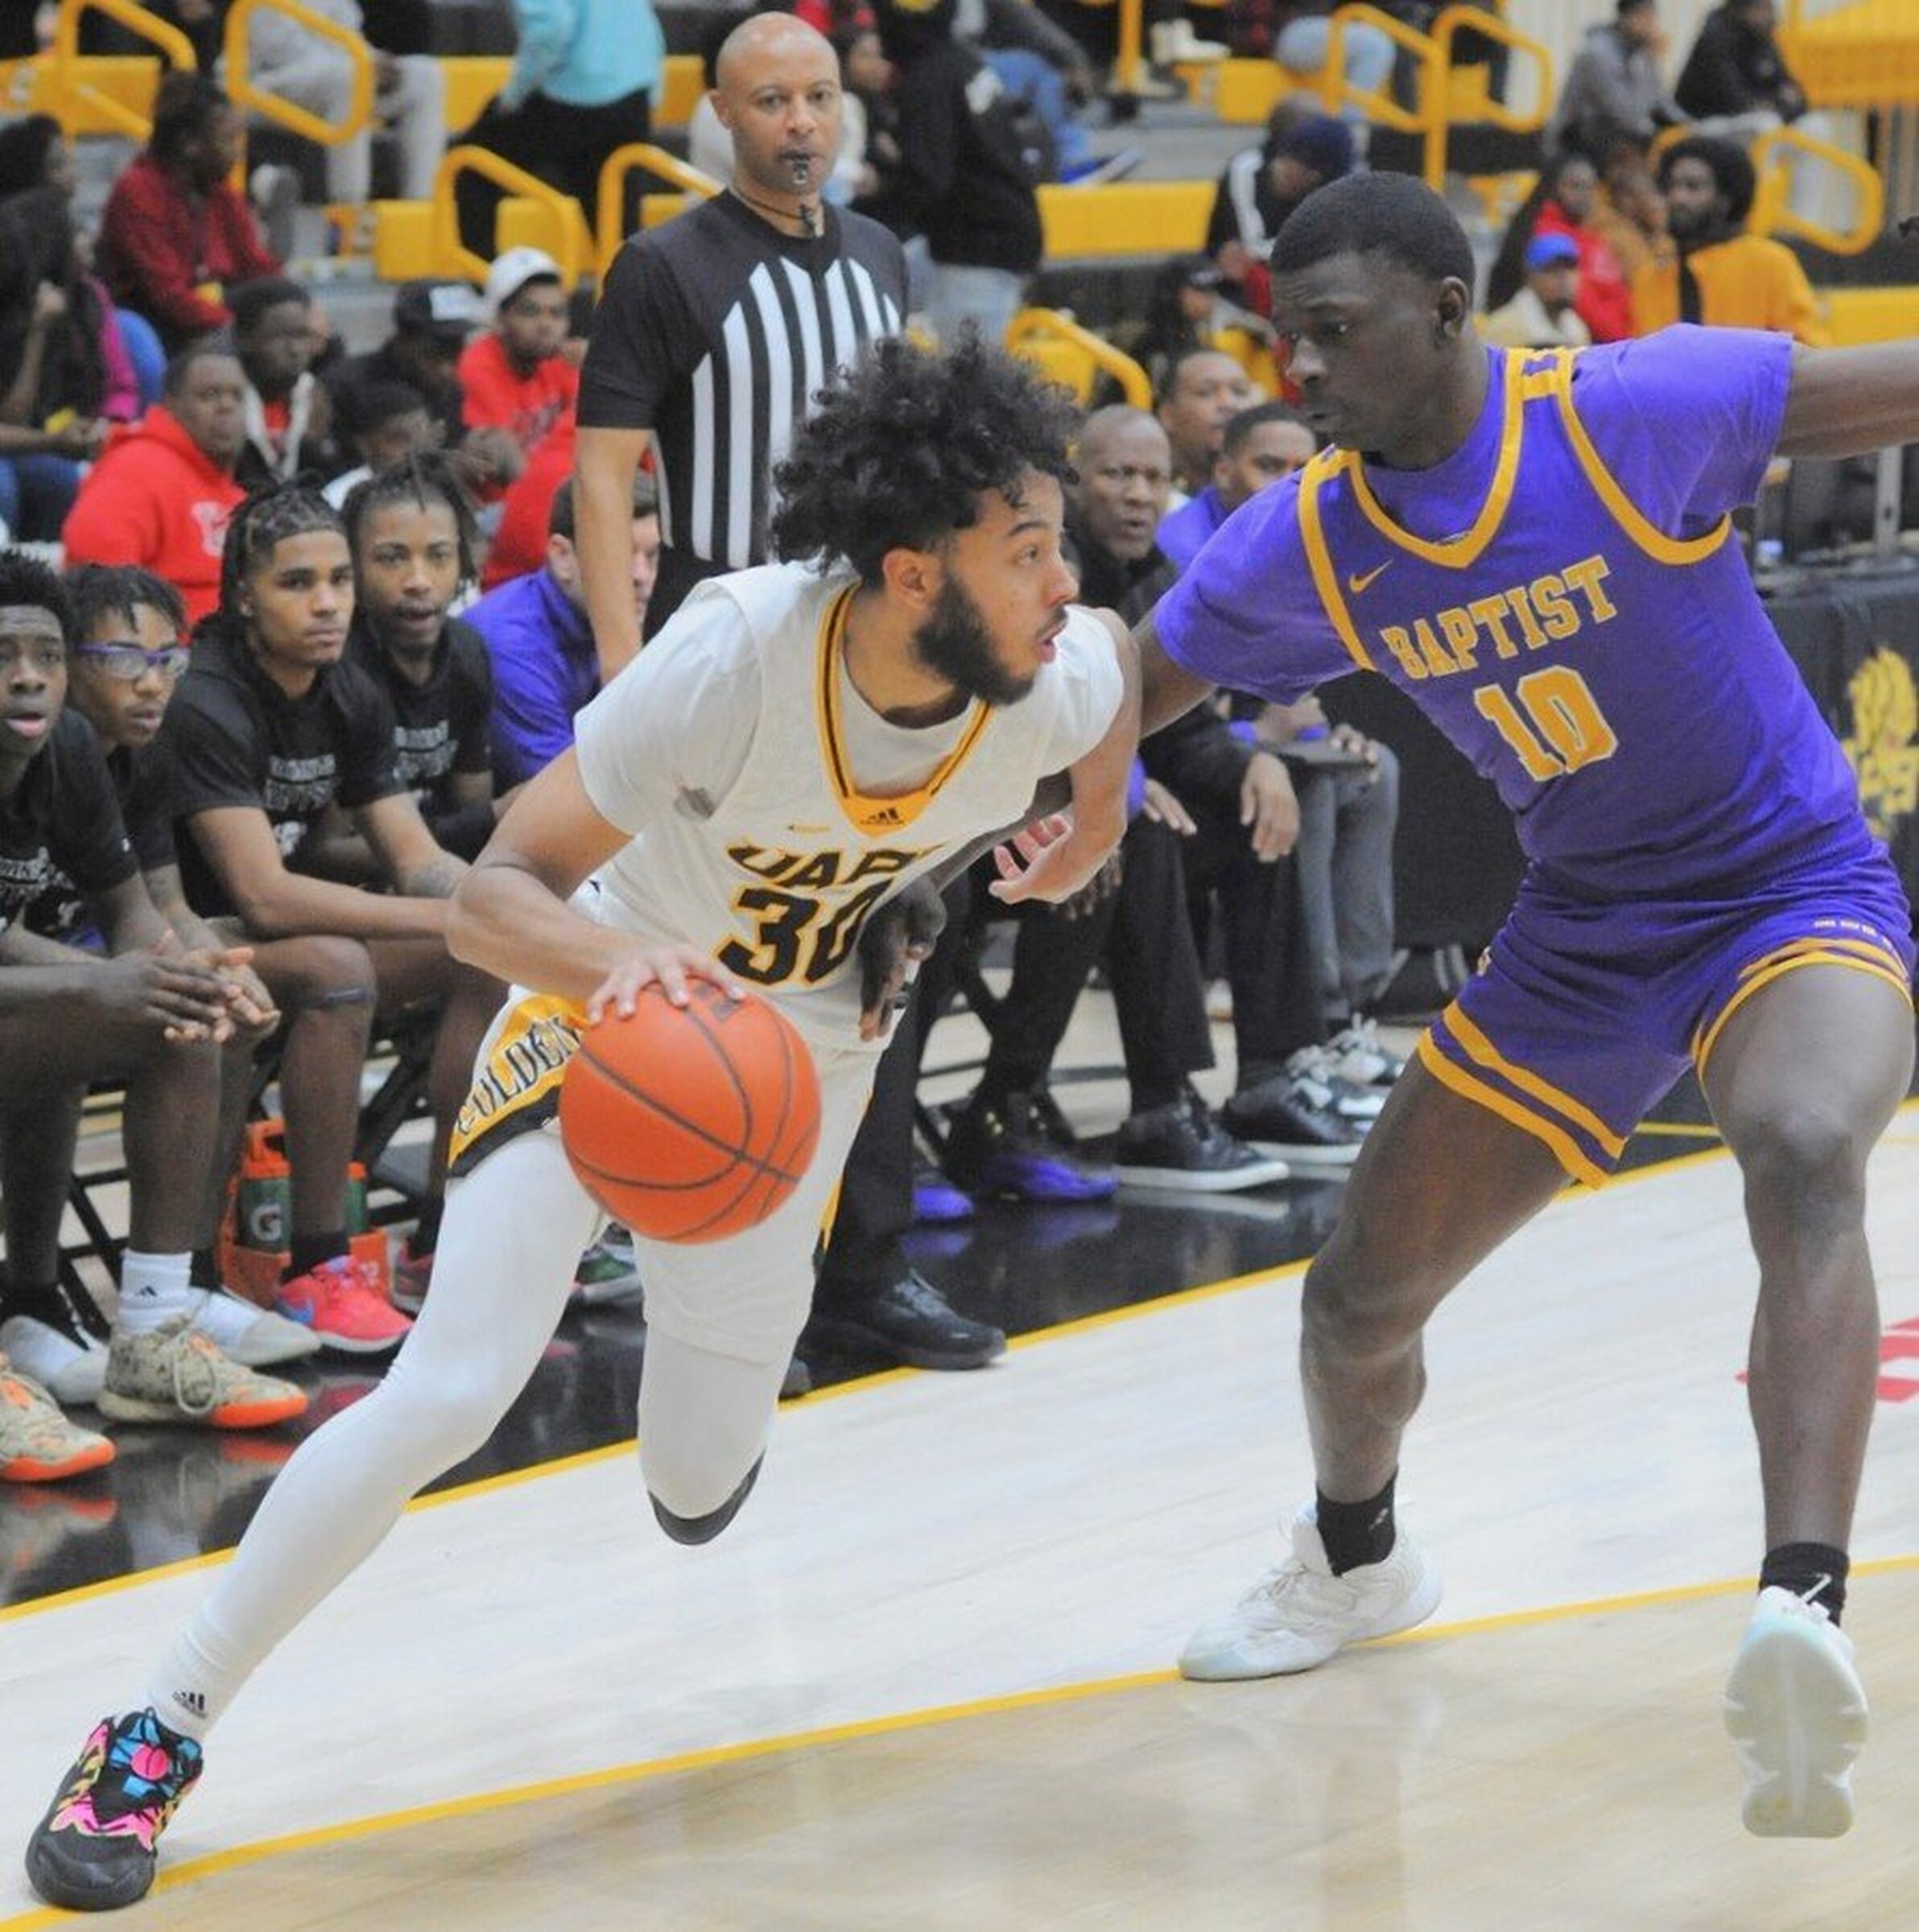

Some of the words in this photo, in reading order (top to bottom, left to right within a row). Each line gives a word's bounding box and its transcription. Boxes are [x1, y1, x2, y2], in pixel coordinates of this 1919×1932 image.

[1379, 555, 1617, 679] BAPTIST
[1473, 665, 1619, 782] 10
[725, 842, 938, 890] UAP
[716, 886, 893, 985] 30
[250, 1203, 282, 1241] G
